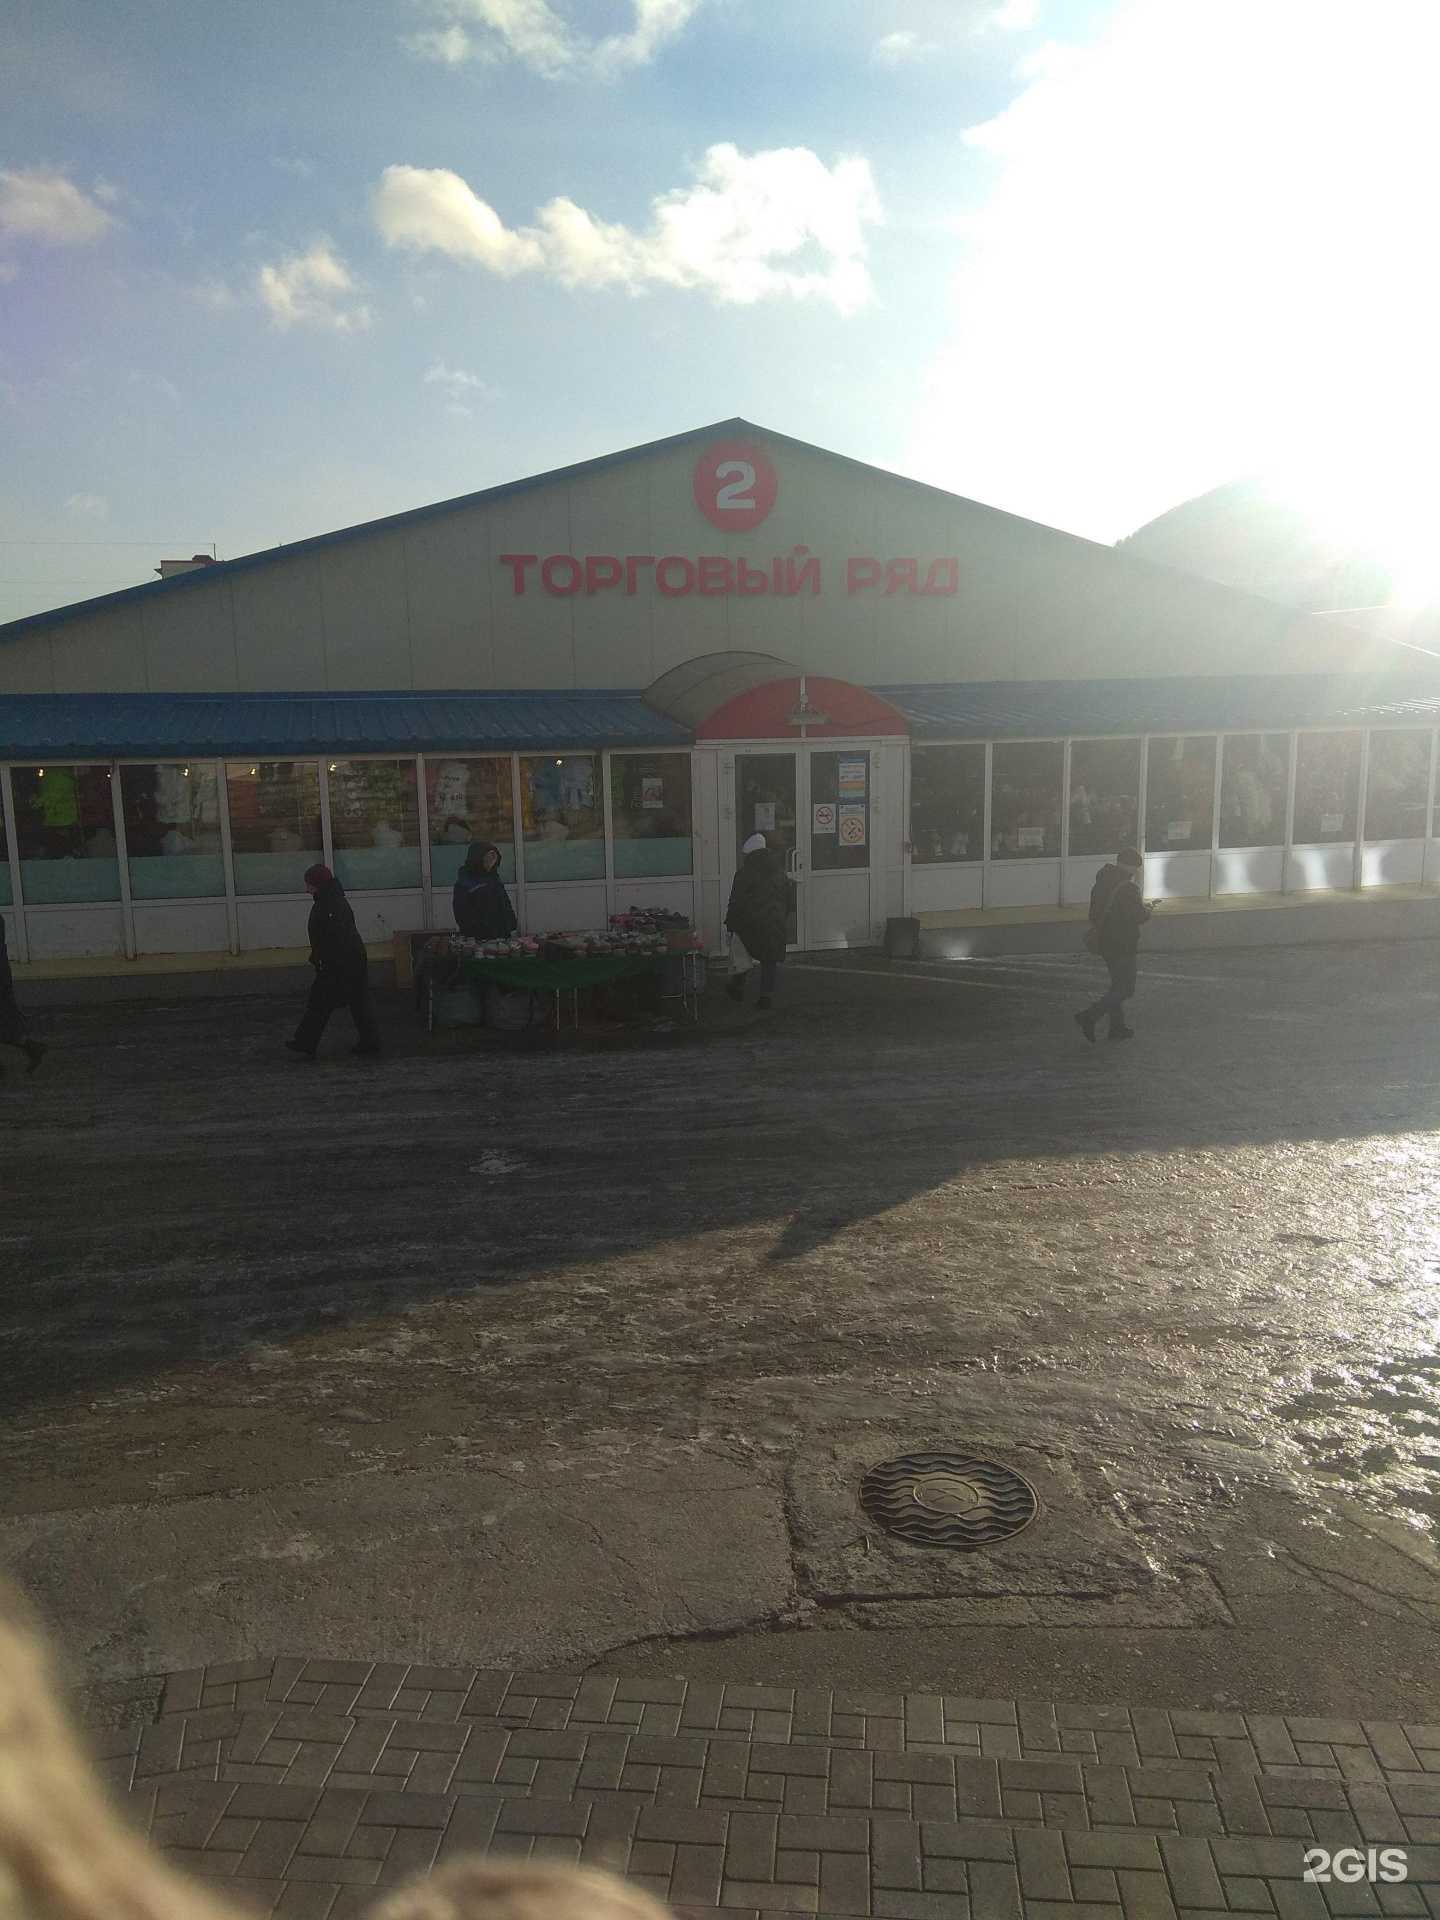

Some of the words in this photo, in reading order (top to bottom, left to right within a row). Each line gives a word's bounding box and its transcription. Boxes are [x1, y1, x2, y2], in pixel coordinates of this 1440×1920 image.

[714, 460, 757, 510] 2
[500, 545, 821, 598] ТОРГОВЫЙ
[847, 556, 960, 597] РЯД
